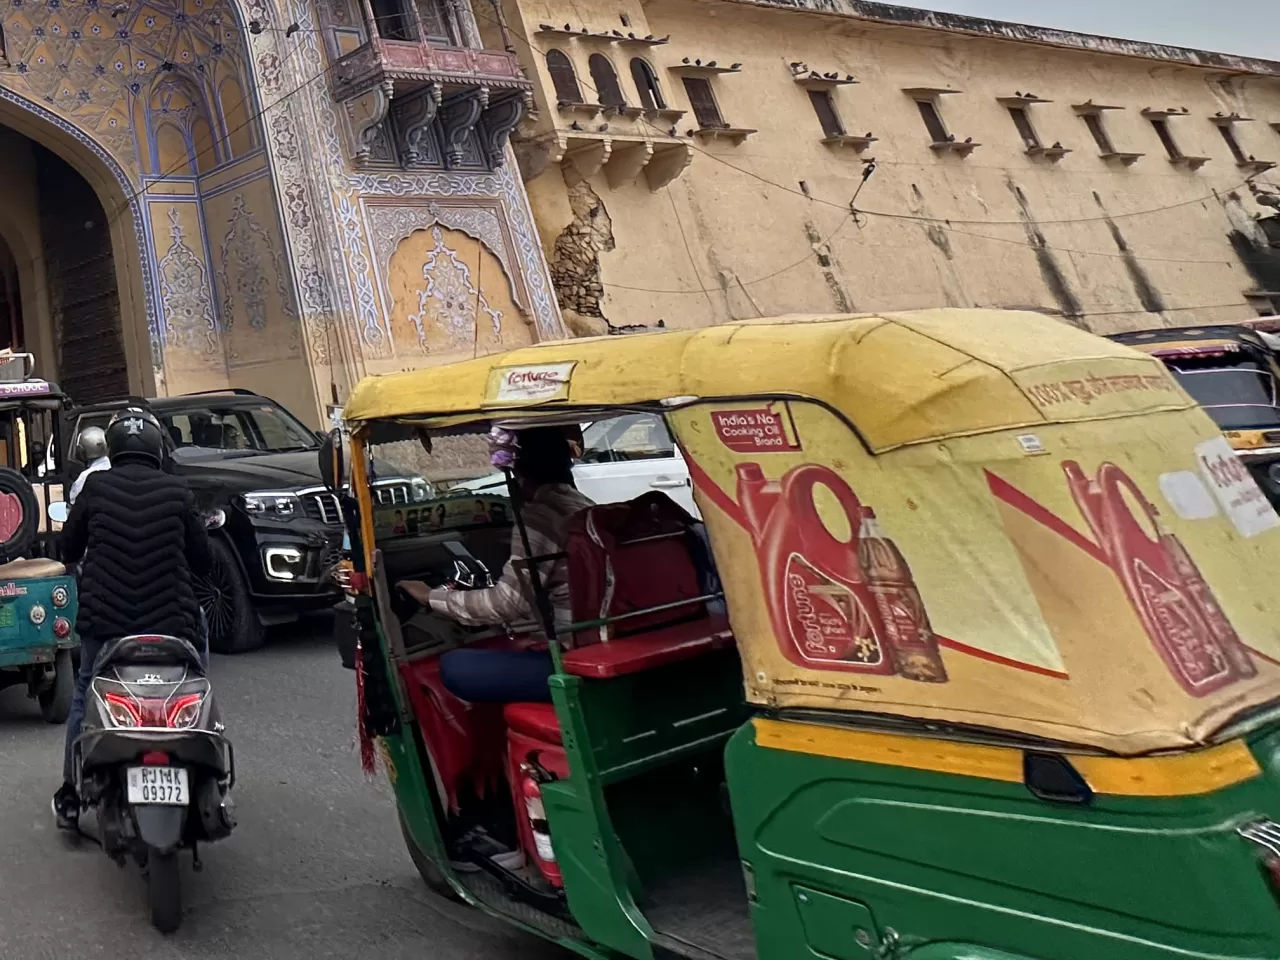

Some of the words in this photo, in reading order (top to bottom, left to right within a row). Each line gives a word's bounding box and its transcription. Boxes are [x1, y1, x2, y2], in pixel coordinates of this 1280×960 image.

[718, 414, 755, 426] India's
[722, 426, 764, 438] Cooking
[765, 425, 780, 435] Oil
[754, 437, 783, 446] Brand
